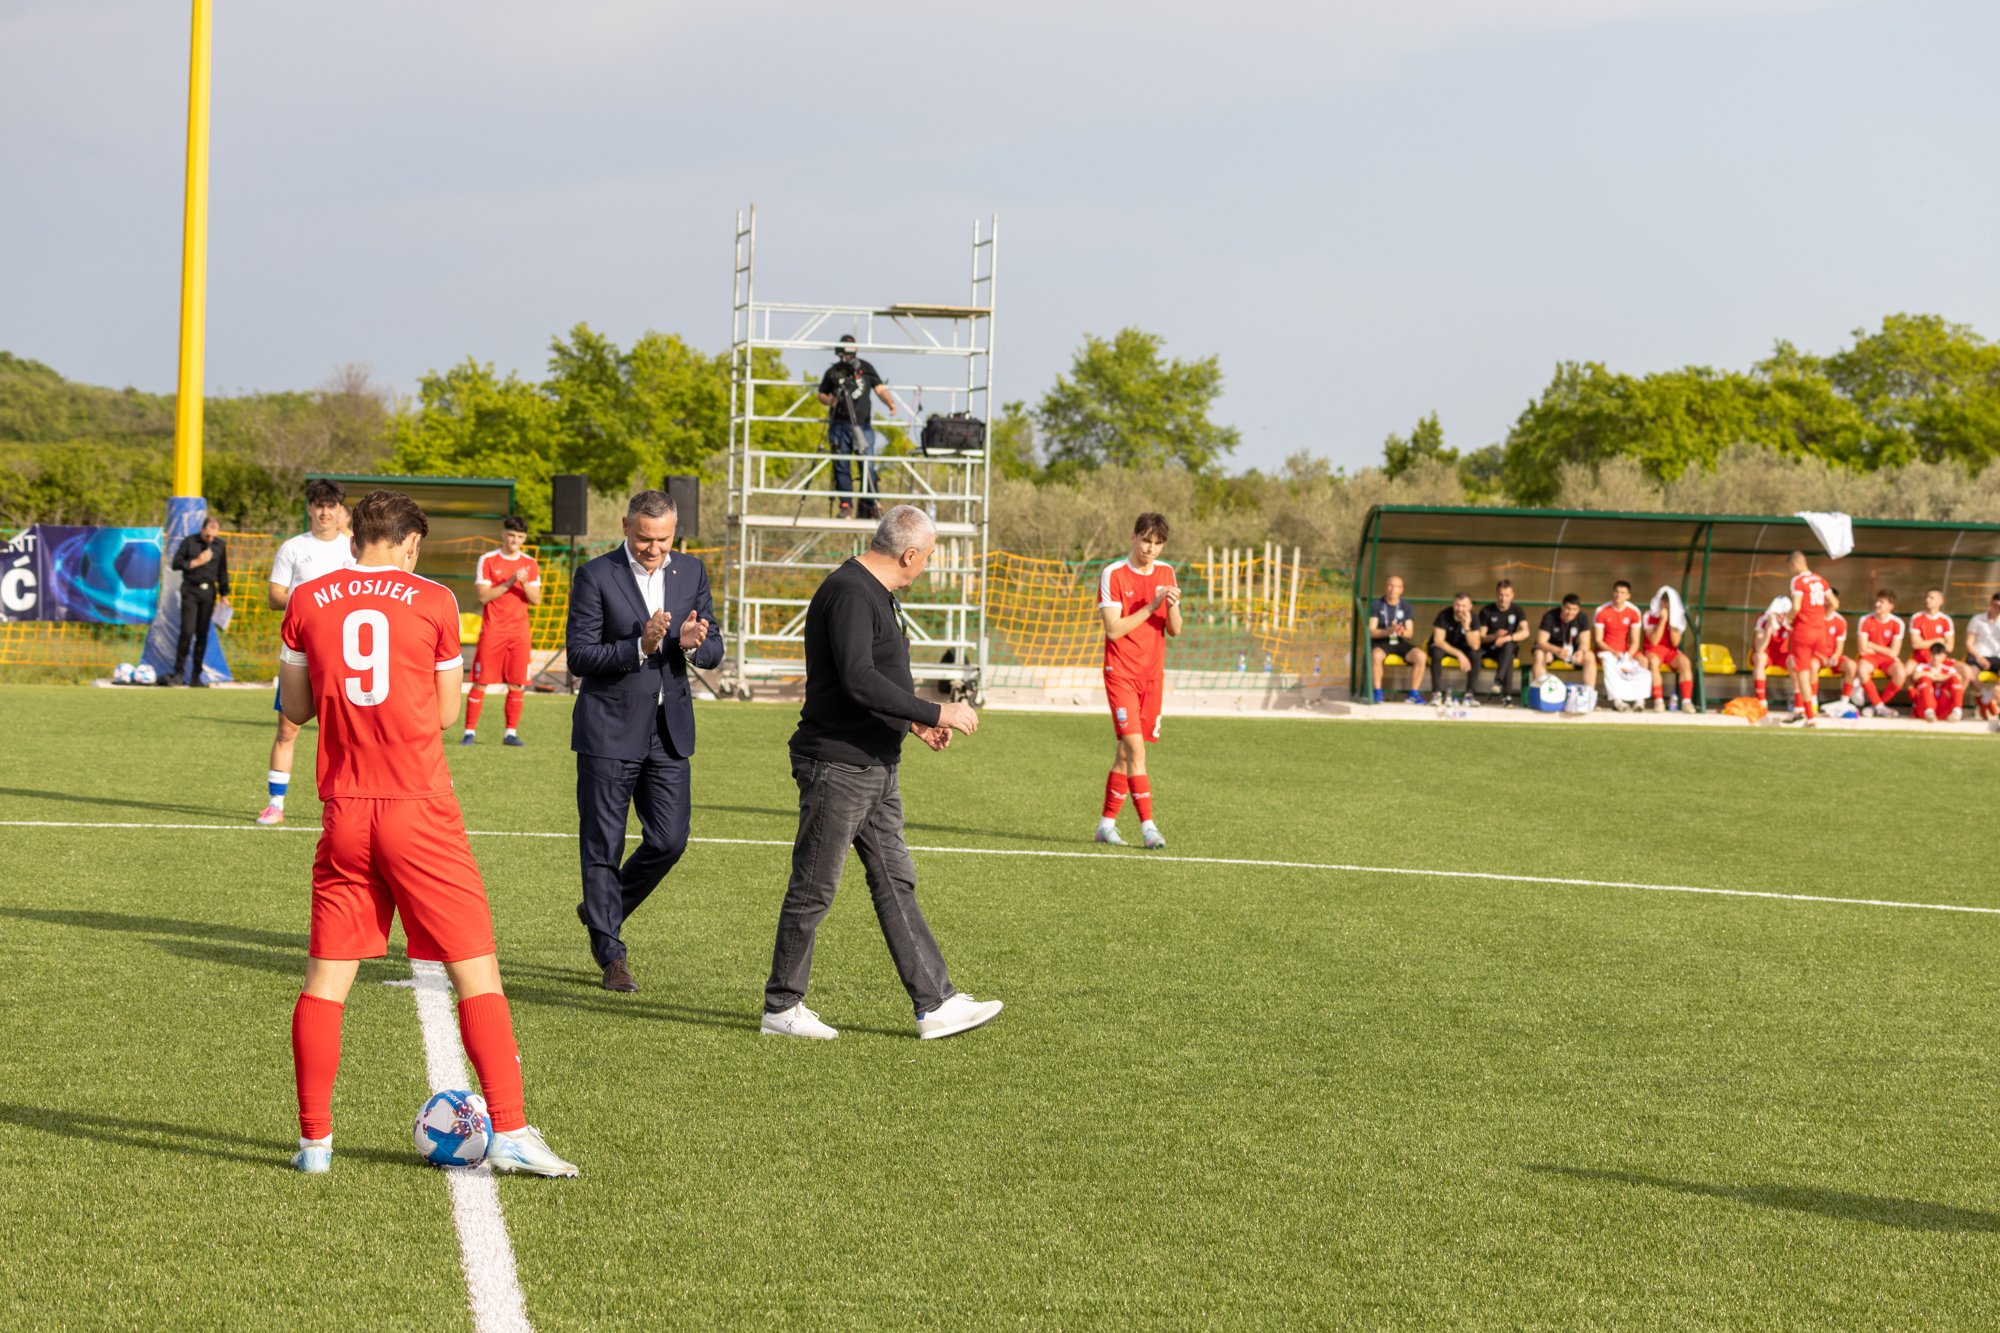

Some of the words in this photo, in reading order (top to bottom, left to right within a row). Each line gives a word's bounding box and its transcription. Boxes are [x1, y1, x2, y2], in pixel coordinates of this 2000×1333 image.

[0, 534, 37, 553] NT
[313, 582, 344, 608] NK
[348, 579, 420, 605] OSIJEK
[342, 608, 390, 707] 9
